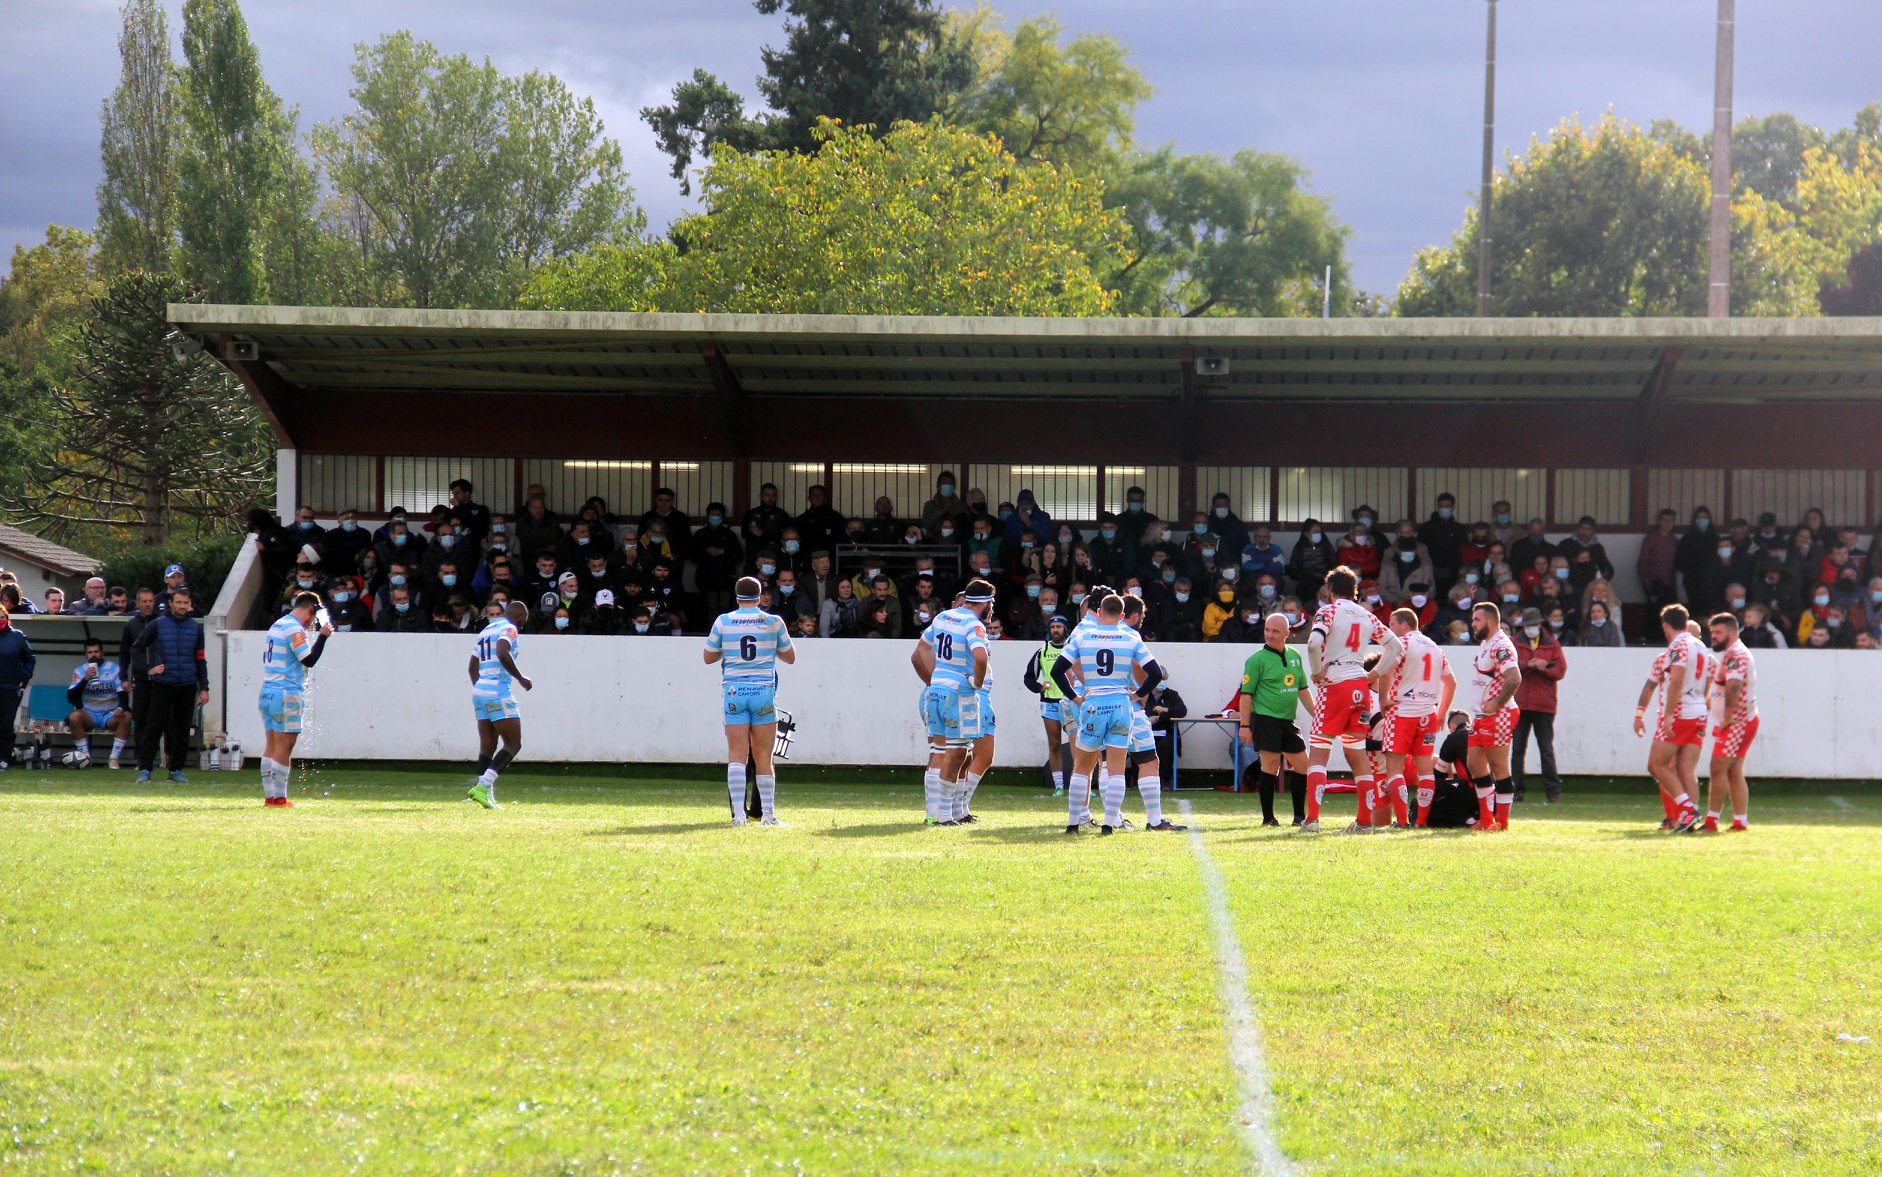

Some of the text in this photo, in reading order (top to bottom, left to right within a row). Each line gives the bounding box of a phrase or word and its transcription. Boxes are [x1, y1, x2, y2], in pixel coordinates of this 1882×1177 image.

[478, 636, 492, 661] 11
[740, 635, 757, 661] 6
[936, 632, 953, 660] 18
[1345, 623, 1360, 652] 4
[1096, 649, 1115, 676] 9
[1422, 653, 1431, 682] 1
